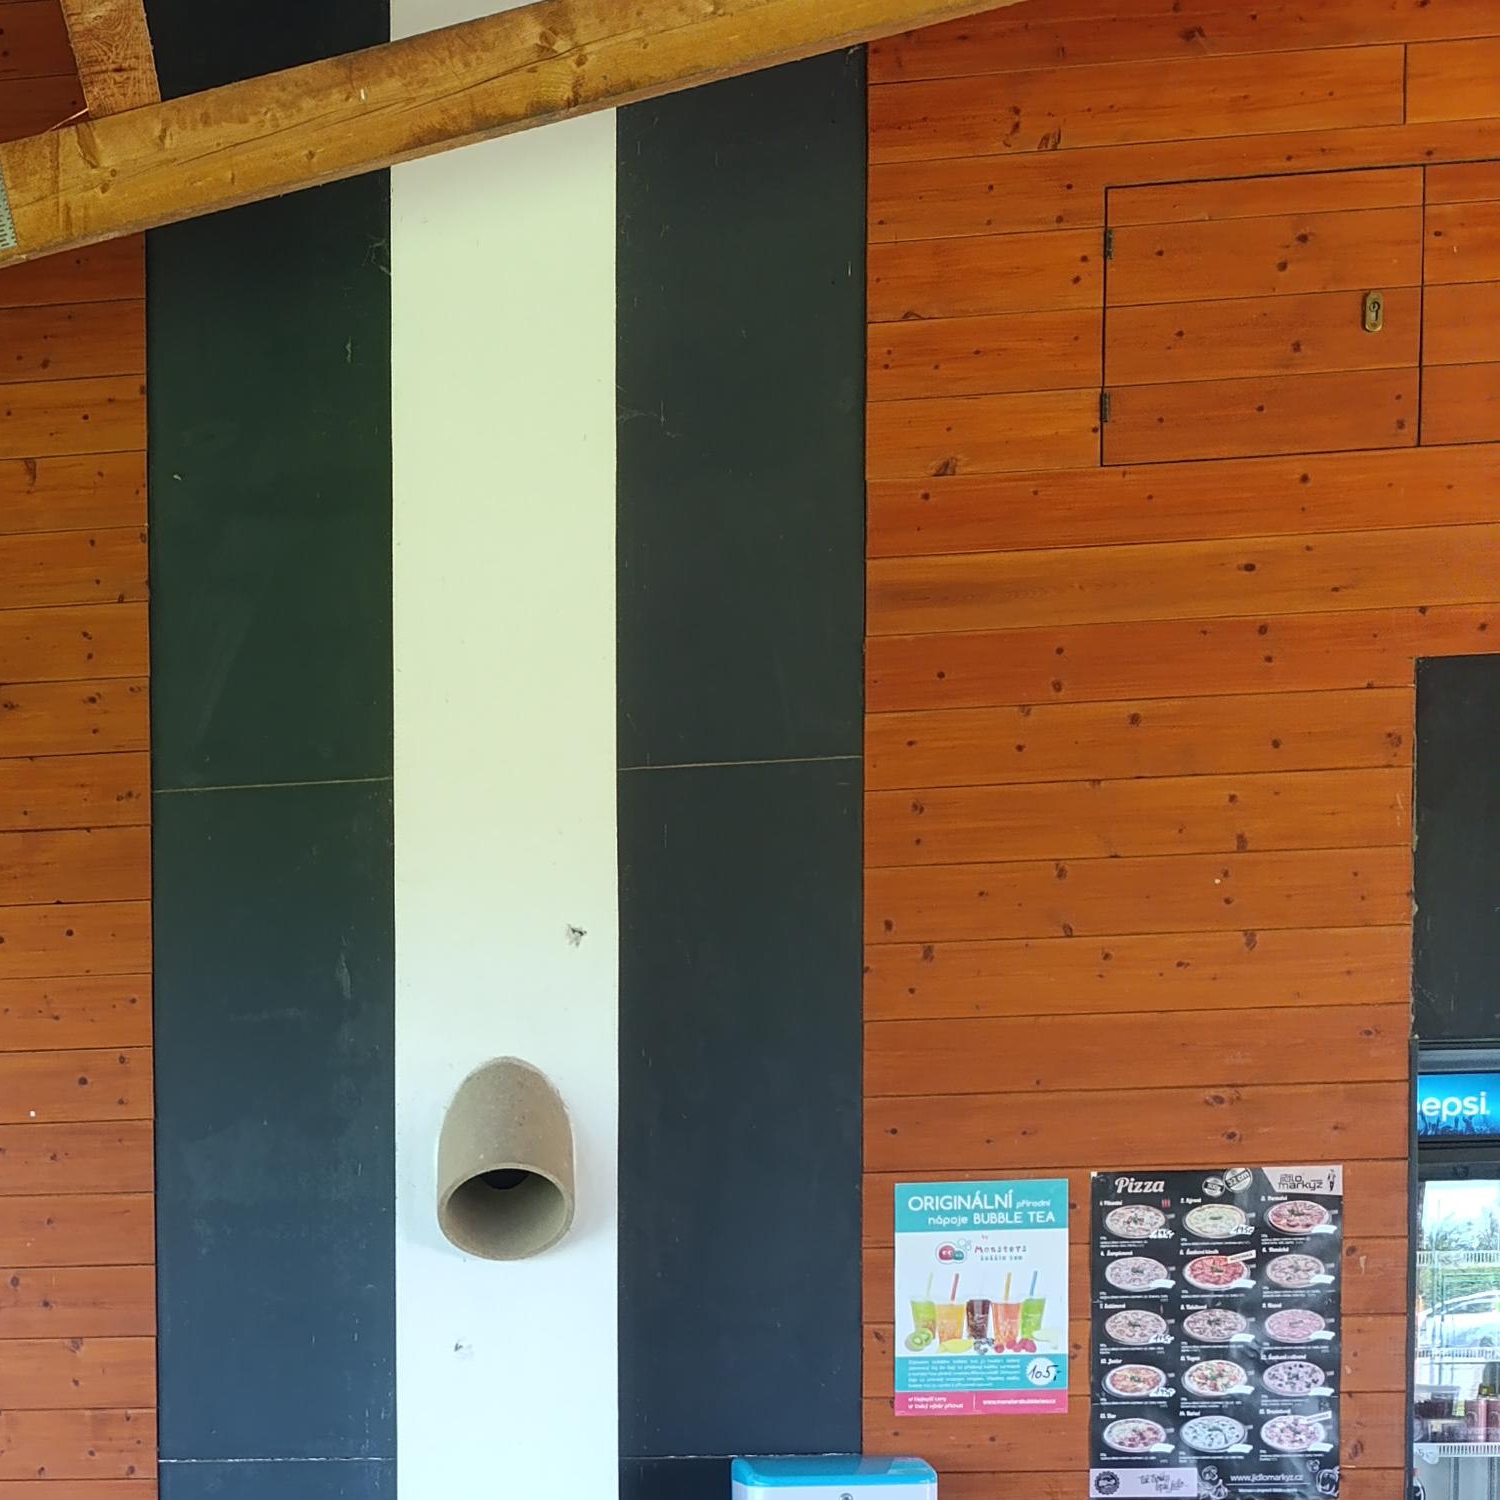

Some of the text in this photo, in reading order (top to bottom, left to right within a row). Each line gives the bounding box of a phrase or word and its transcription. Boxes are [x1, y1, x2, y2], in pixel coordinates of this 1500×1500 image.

[1114, 1176, 1165, 1194] Pizza
[907, 1189, 1014, 1212] ORIGINÁLNÍ
[928, 1211, 1056, 1227] nápoje BUBBLE TEA
